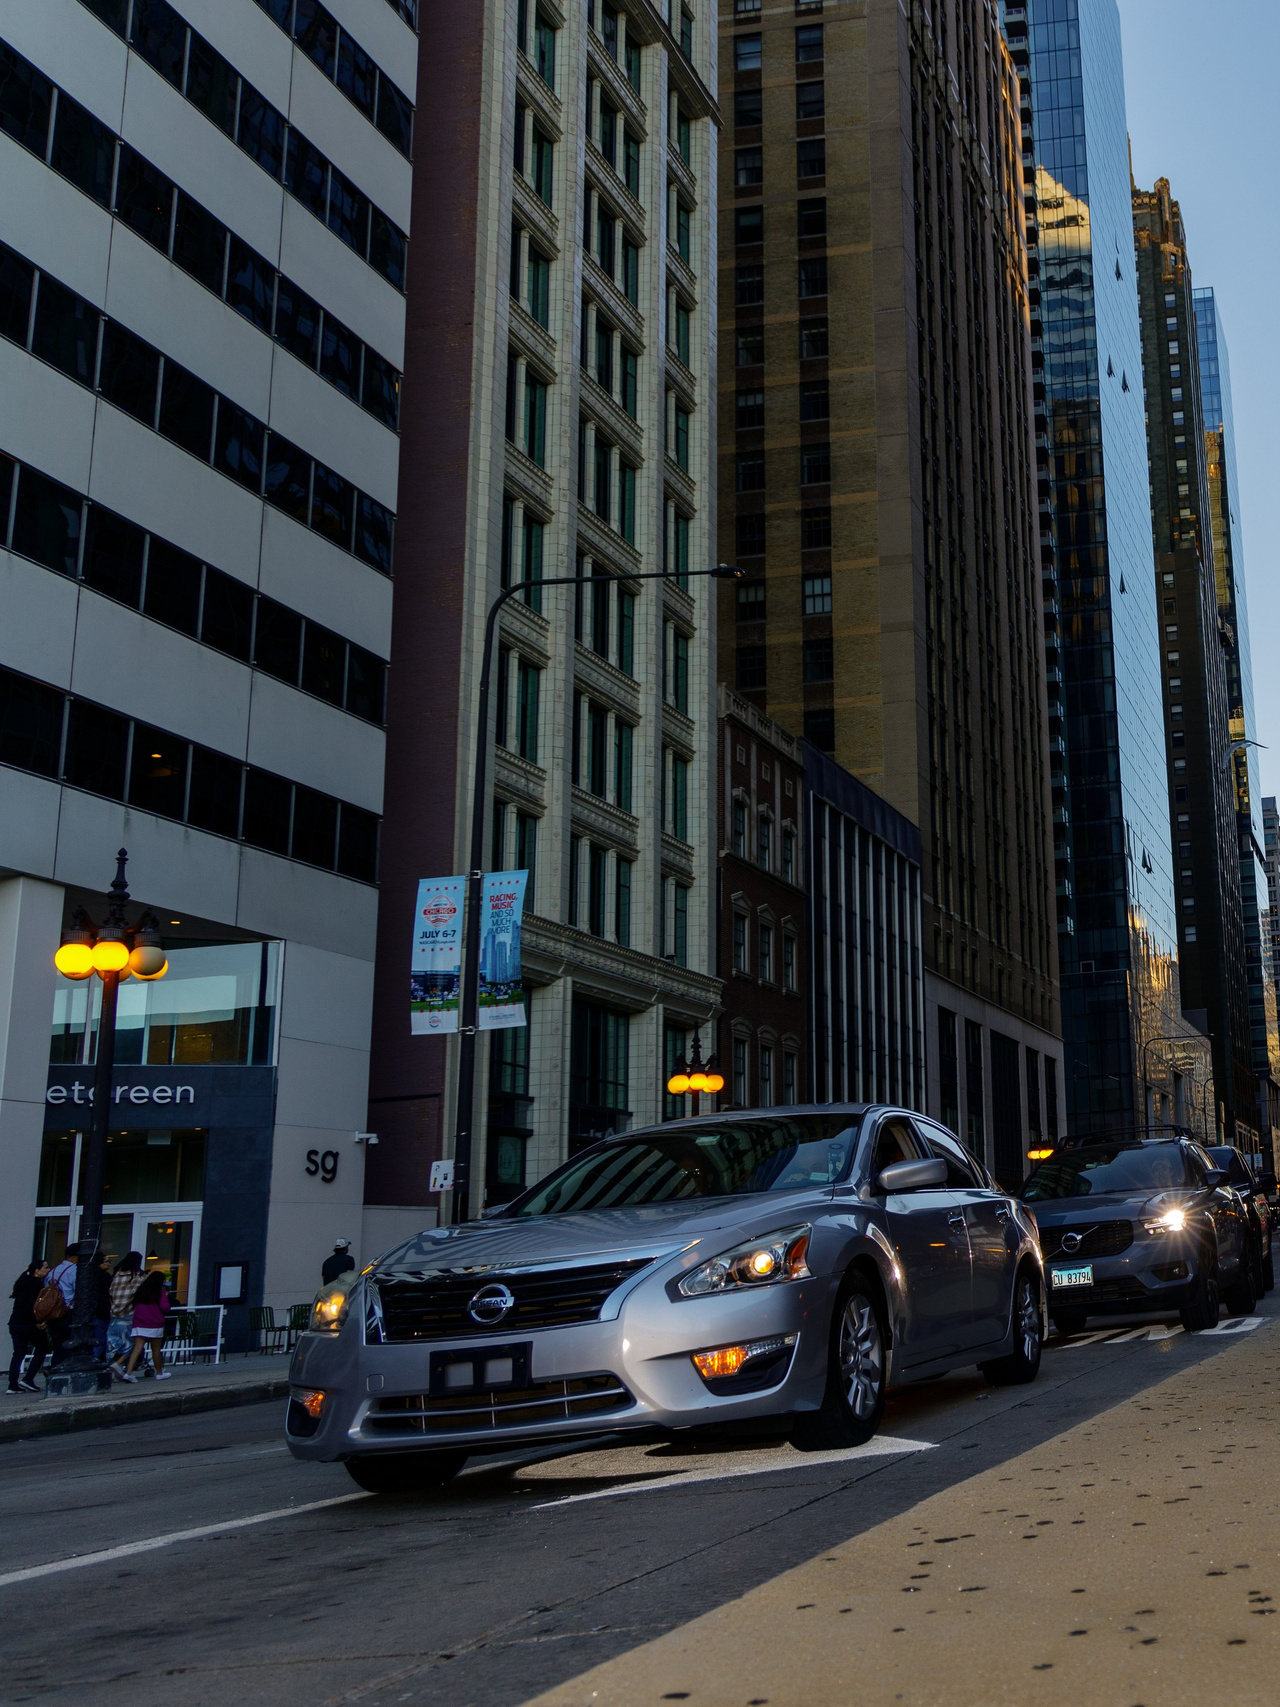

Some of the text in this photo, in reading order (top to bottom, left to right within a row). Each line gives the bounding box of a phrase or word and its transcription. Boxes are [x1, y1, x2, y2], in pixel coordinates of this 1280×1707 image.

[489, 893, 518, 903] RACING,
[491, 901, 513, 910] MUSIC
[425, 907, 454, 915] CHICAGO
[490, 909, 514, 919] AND SO
[491, 918, 511, 927] MUCH
[419, 930, 456, 939] JULY 6-7
[491, 926, 510, 934] MORE
[46, 1080, 195, 1108] etreen
[305, 1149, 339, 1183] sg
[1053, 1271, 1091, 1285] CU 83794
[471, 1299, 508, 1309] NISSAN
